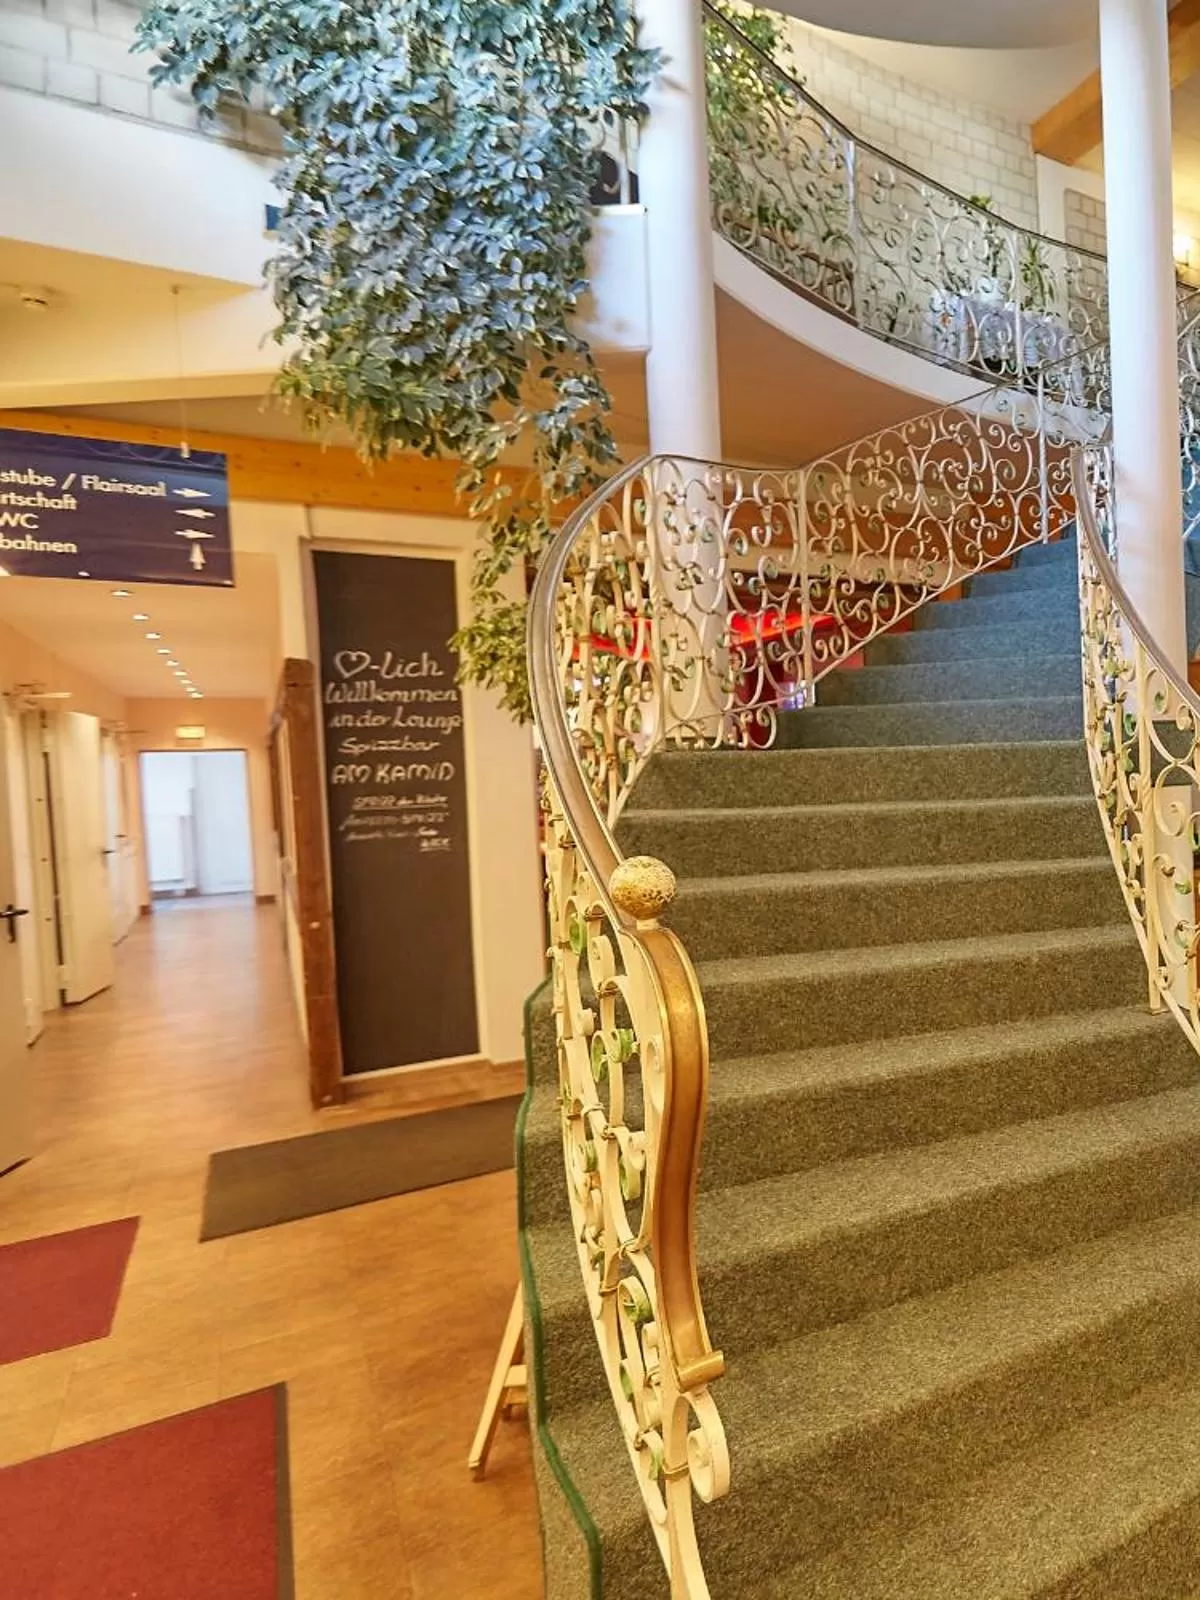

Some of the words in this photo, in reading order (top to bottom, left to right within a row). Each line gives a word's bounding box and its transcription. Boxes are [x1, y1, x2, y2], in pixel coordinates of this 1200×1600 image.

[81, 474, 167, 497] Flairsaal
[0, 491, 77, 510] rtschaft
[0, 511, 39, 529] WC
[325, 680, 458, 704] Willkommen
[332, 763, 371, 784] AM
